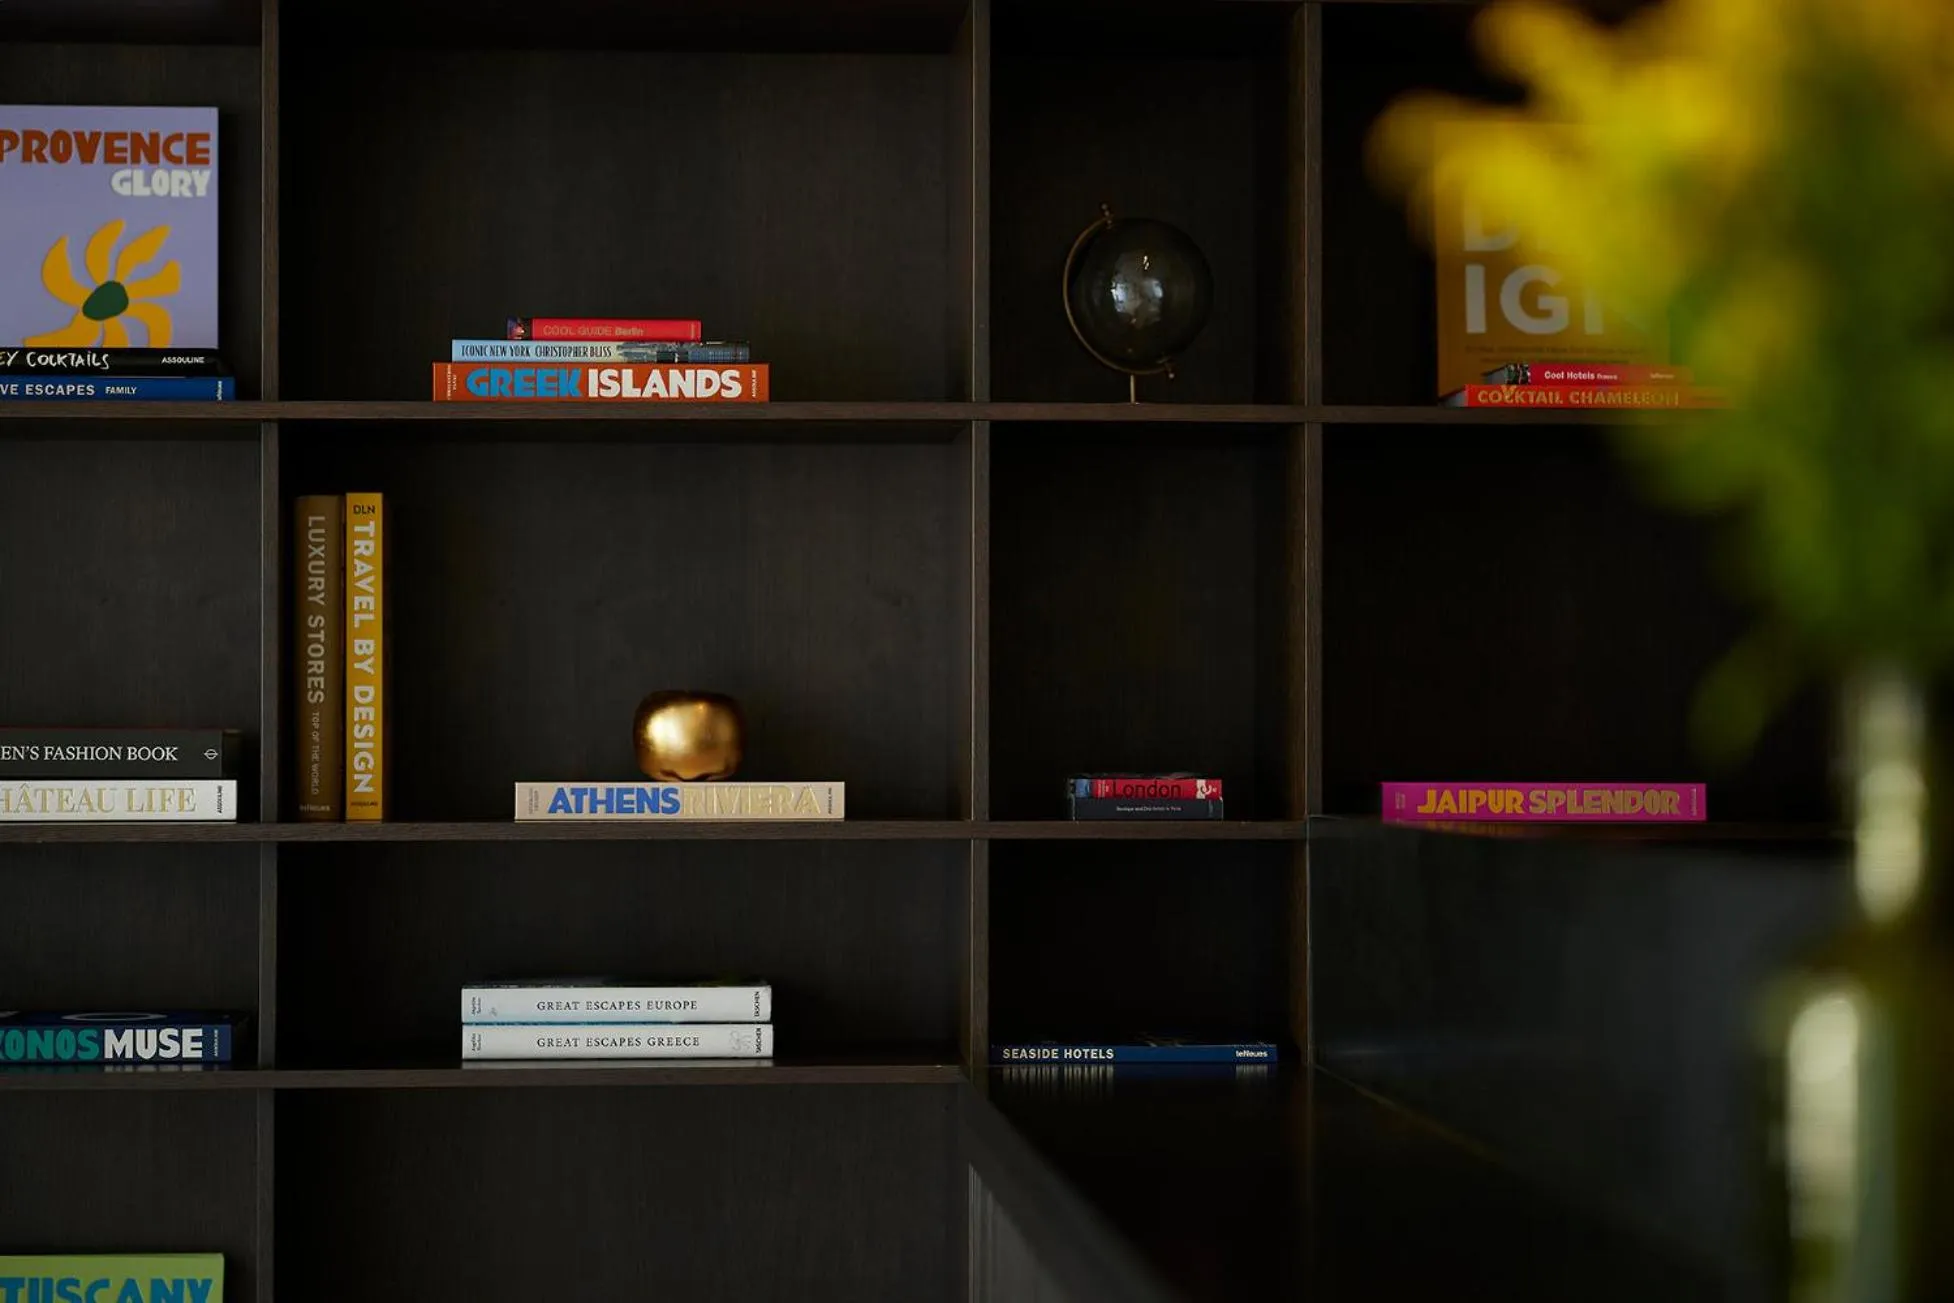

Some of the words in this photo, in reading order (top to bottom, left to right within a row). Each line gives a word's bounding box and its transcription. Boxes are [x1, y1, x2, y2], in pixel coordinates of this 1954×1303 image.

[0, 130, 210, 165] PROVENCE
[111, 169, 211, 197] GLORY
[543, 325, 575, 337] COOL
[578, 325, 613, 337] GUIDE
[615, 326, 645, 338] Berlin
[461, 344, 488, 358] ICONIC
[489, 344, 507, 358] NEW
[509, 345, 531, 358] YORK
[535, 345, 588, 358] CHRISTOPHER
[589, 345, 612, 358] BLISS
[160, 355, 206, 366] ASSOULINE
[465, 367, 583, 398] GREEK
[587, 368, 743, 399] ISLANDS
[1544, 371, 1564, 380] Cool
[1567, 371, 1595, 380] Hotels
[25, 383, 96, 397] ESCAPES
[105, 386, 138, 396] FAMILY
[1477, 389, 1563, 404] COCKTAIL
[353, 504, 376, 515] DLN
[306, 516, 326, 606] LUXURY
[353, 520, 375, 628] TRAVEL
[306, 615, 325, 705] STORES
[353, 639, 375, 674] BY
[311, 711, 320, 729] TOP
[311, 731, 320, 741] OF
[353, 686, 375, 793] DESIGN
[44, 745, 122, 761] FASHION
[127, 746, 178, 762] BOOK
[311, 745, 320, 761] THE
[311, 763, 321, 795] WORLD
[1113, 780, 1182, 798] London
[125, 787, 197, 813] LIFE
[548, 787, 681, 814] ATHENS
[683, 786, 822, 815] RIVIERA
[1417, 788, 1525, 814] JAIPUR
[1529, 788, 1681, 814] SPLENDOR
[537, 1000, 581, 1011] GREAT
[585, 1000, 641, 1011] ESCAPES
[646, 1000, 698, 1011] EUROPE
[104, 1028, 203, 1060] MUSE
[537, 1037, 581, 1048] GREAT
[585, 1037, 641, 1047] ESCAPES
[646, 1036, 700, 1047] GREECE
[1002, 1048, 1059, 1060] SEASIDE
[1063, 1048, 1115, 1060] HOTELS
[0, 1278, 212, 1303] TUSCANY
